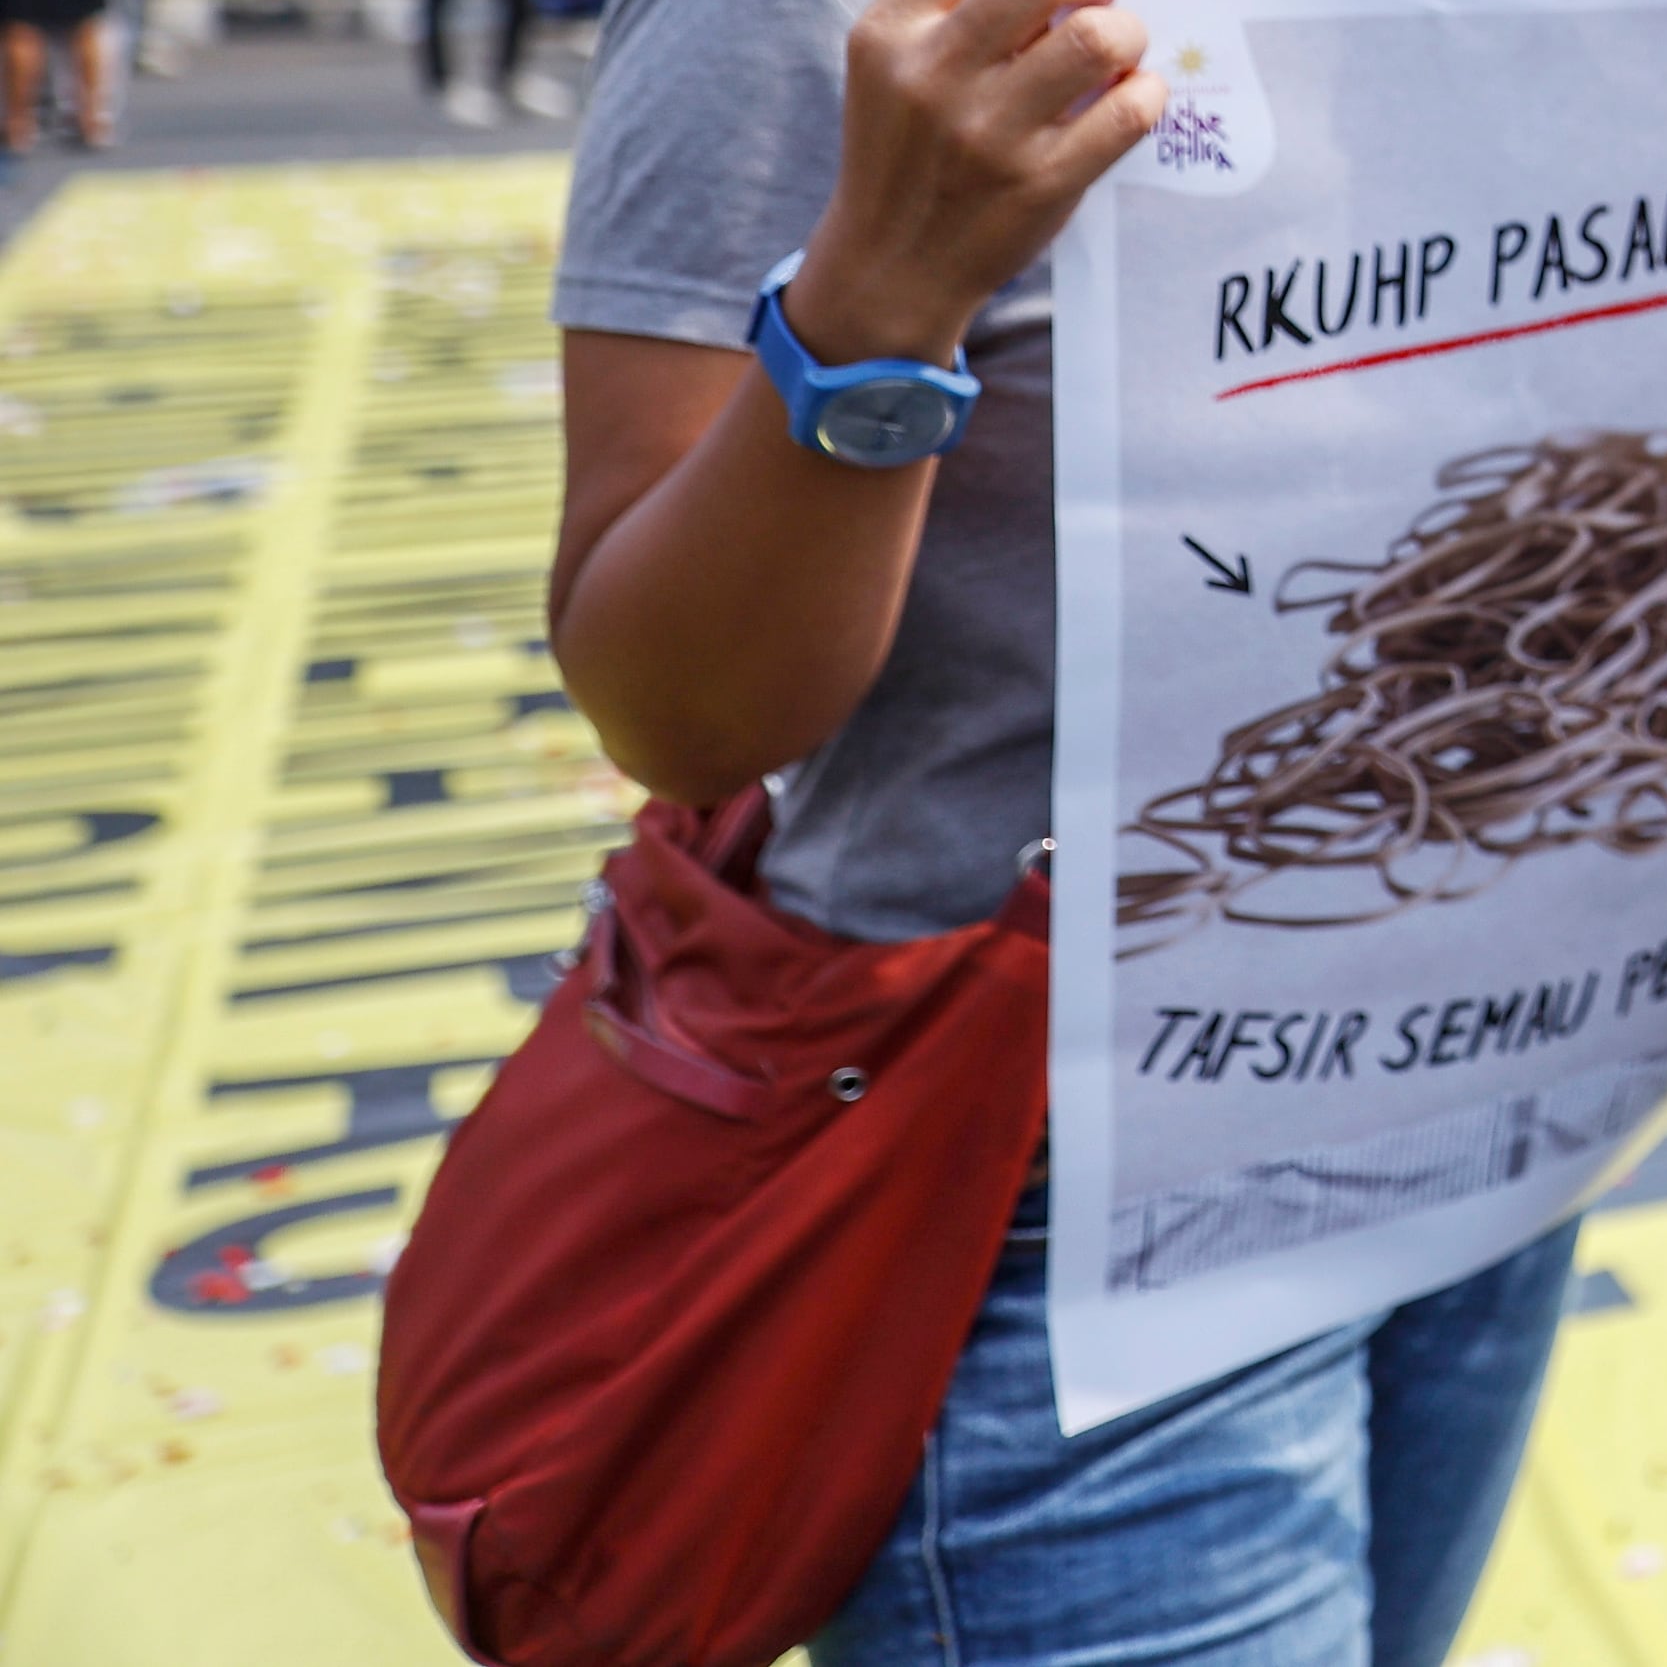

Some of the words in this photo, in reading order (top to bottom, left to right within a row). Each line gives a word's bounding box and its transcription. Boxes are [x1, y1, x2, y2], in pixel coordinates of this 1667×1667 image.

[1214, 233, 1456, 360] RKUHP
[1137, 1007, 1369, 1082] TAFSIR
[1379, 969, 1600, 1073] SEMAU
